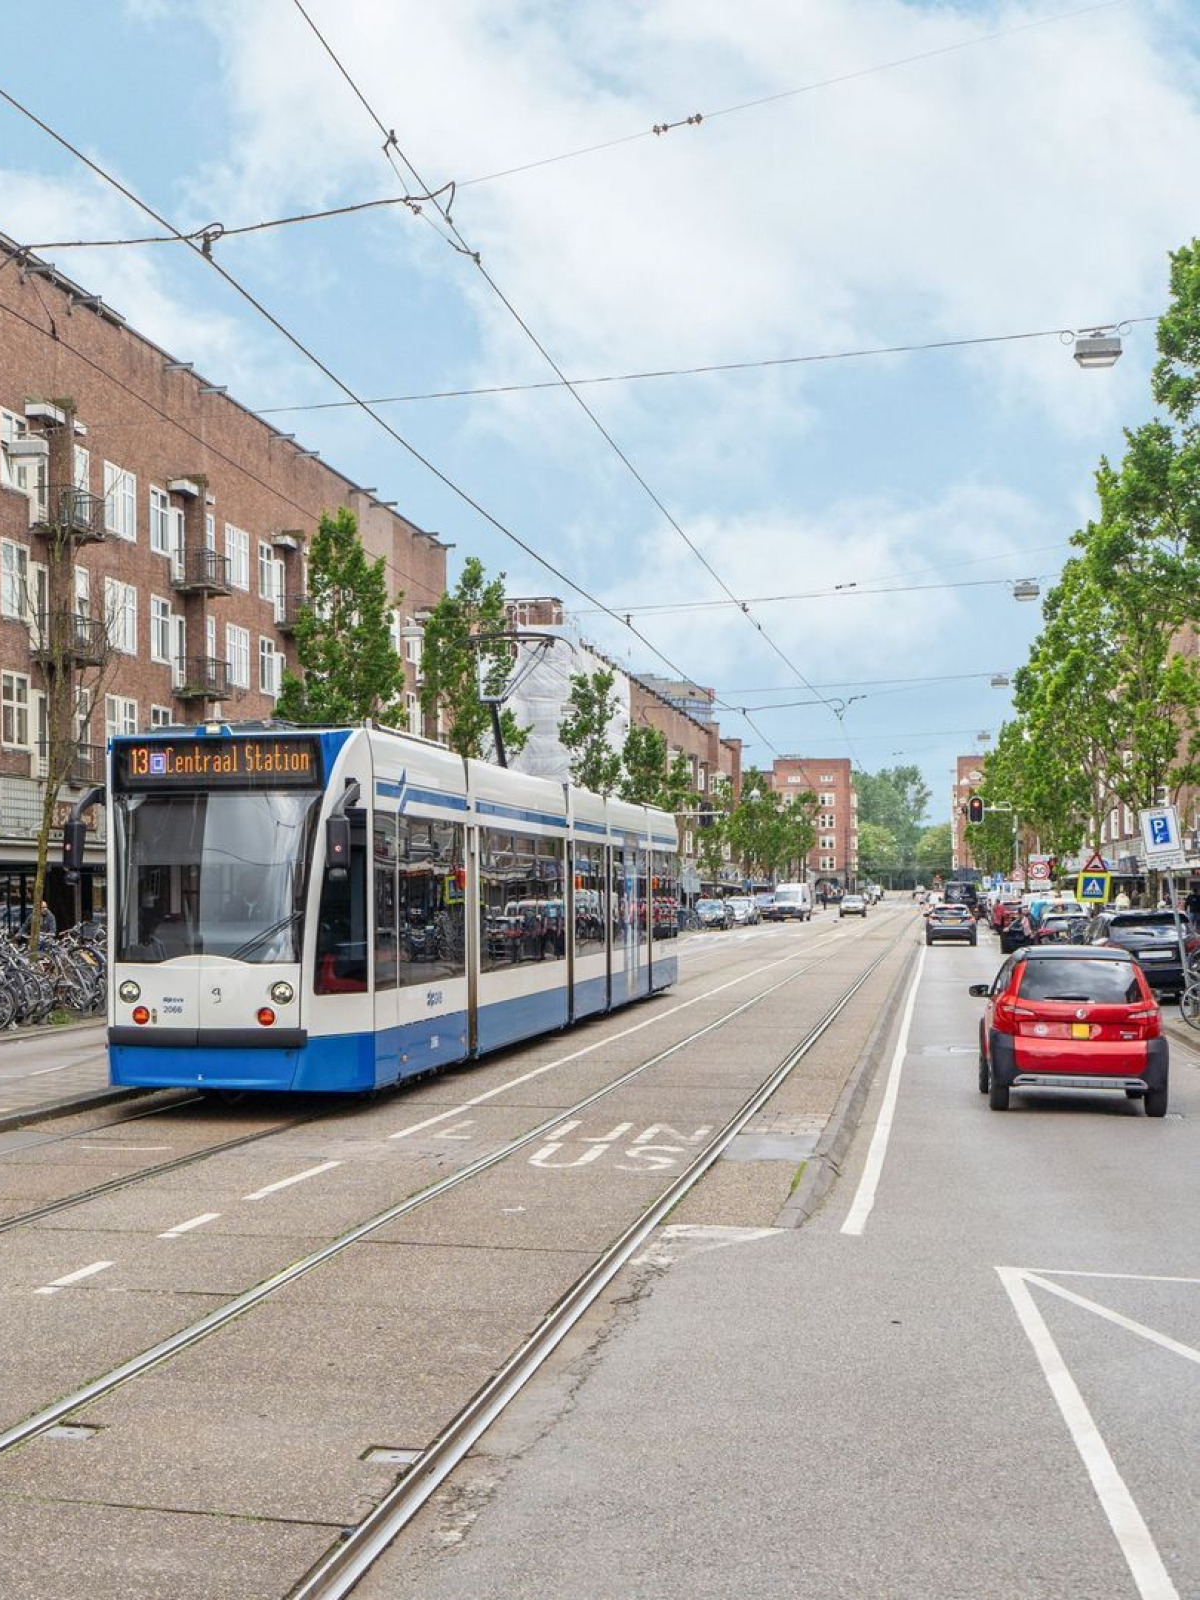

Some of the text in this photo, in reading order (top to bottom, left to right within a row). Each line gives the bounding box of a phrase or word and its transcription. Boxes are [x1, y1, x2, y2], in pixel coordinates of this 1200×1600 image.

[131, 743, 310, 775] 13 Centraal Station
[1034, 866, 1046, 875] 30
